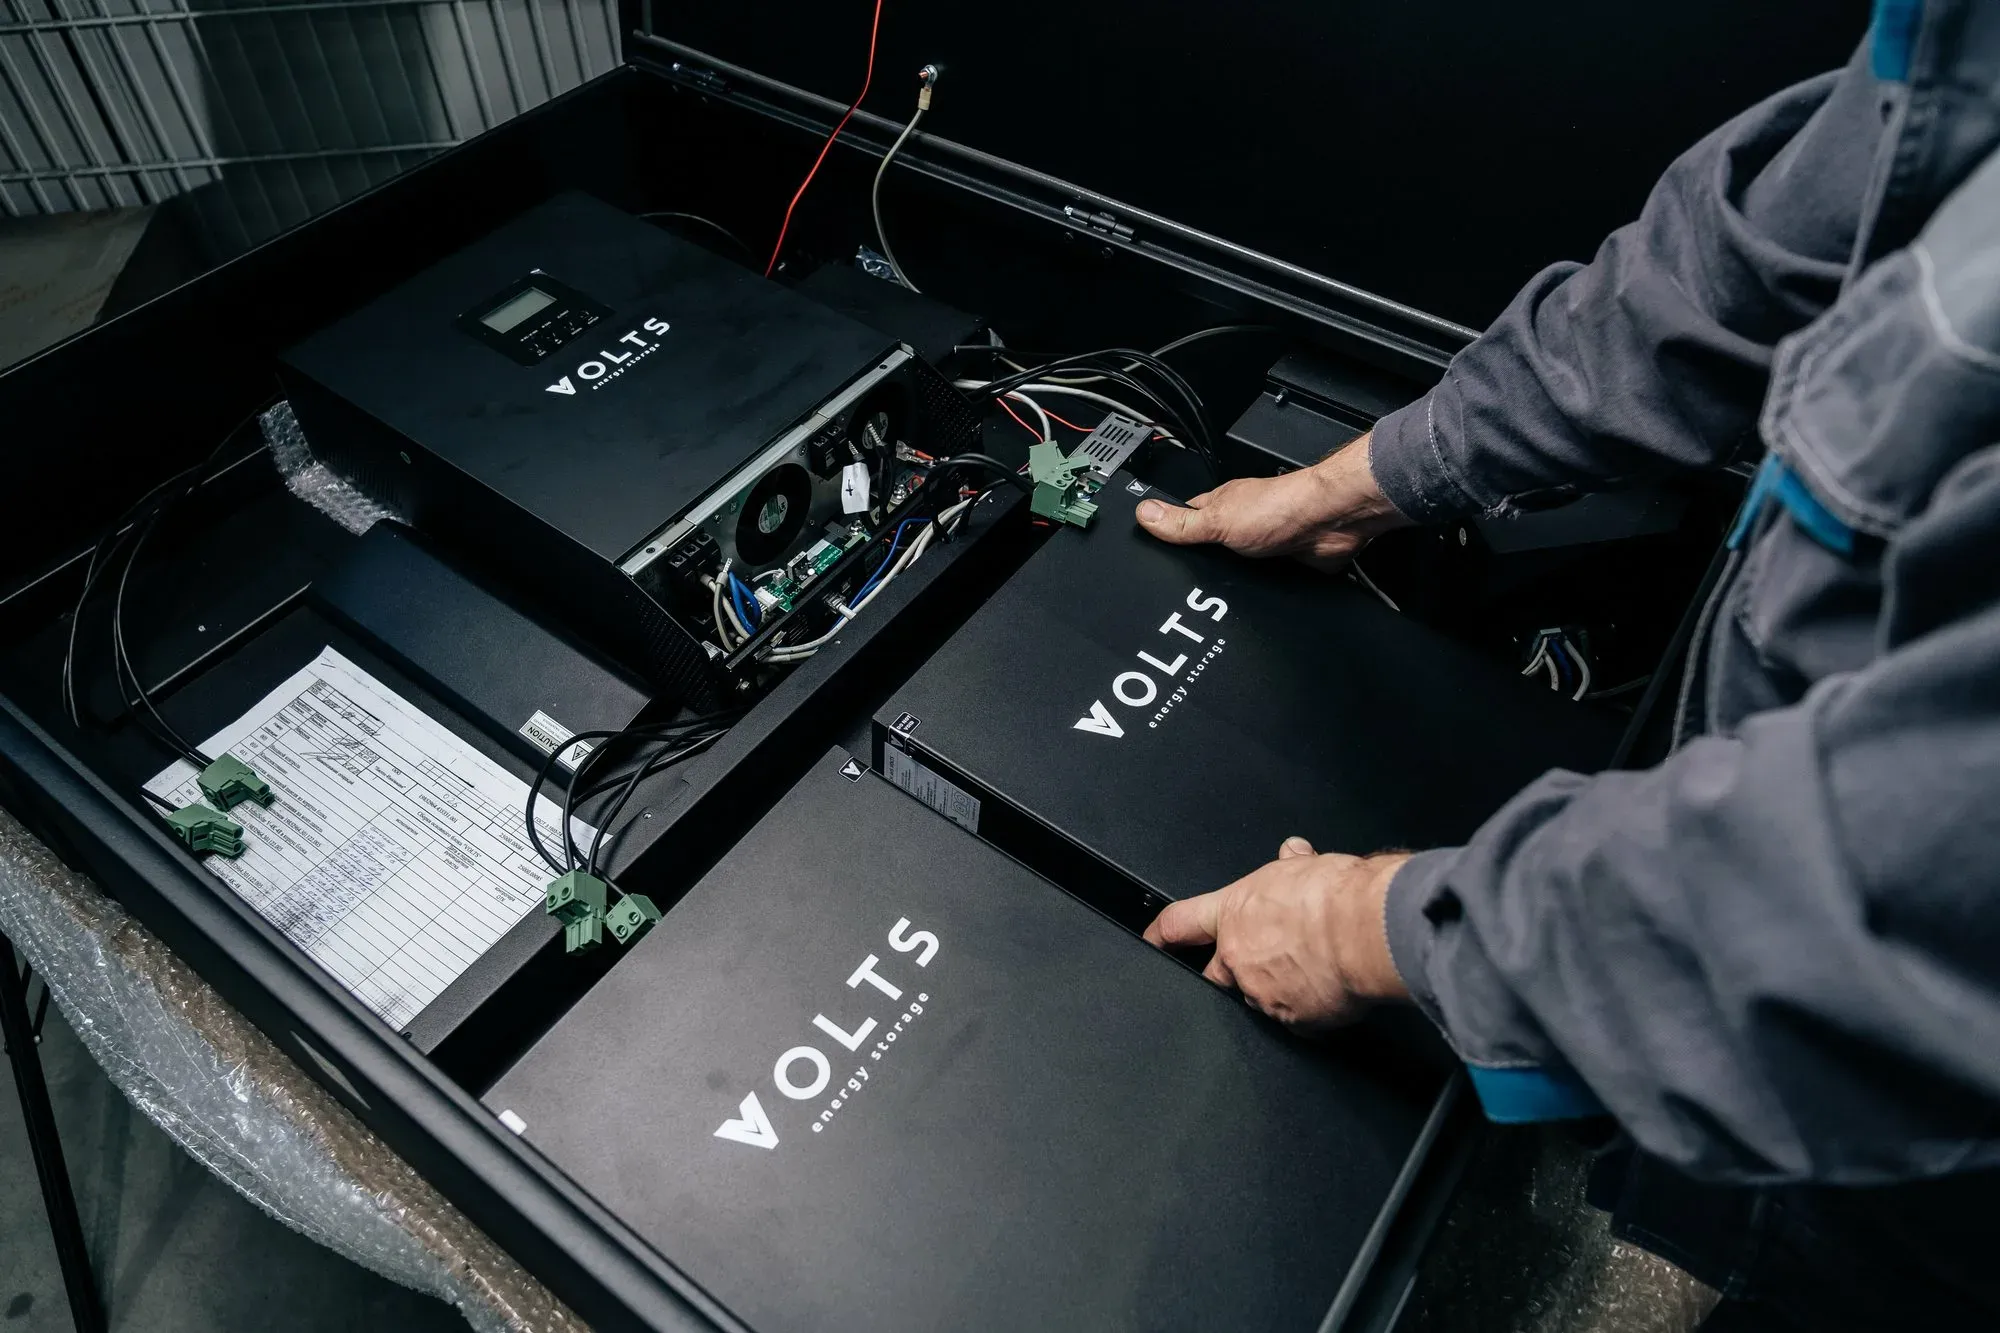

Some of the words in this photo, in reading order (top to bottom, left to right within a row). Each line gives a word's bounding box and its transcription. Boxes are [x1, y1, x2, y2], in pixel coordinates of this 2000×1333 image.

[545, 317, 671, 396] VOLTS
[592, 367, 625, 392] energy
[626, 343, 661, 367] storage
[1072, 587, 1228, 739] VOLTS
[1148, 685, 1188, 729] energy
[1186, 638, 1226, 683] storage
[527, 726, 559, 750] CAUTION
[316, 809, 328, 819] блока
[416, 811, 432, 824] Сборка
[450, 835, 463, 846] блока
[295, 843, 308, 855] блока
[712, 916, 940, 1150] VOLTS
[811, 1066, 869, 1133] energy
[870, 992, 929, 1061] storage
